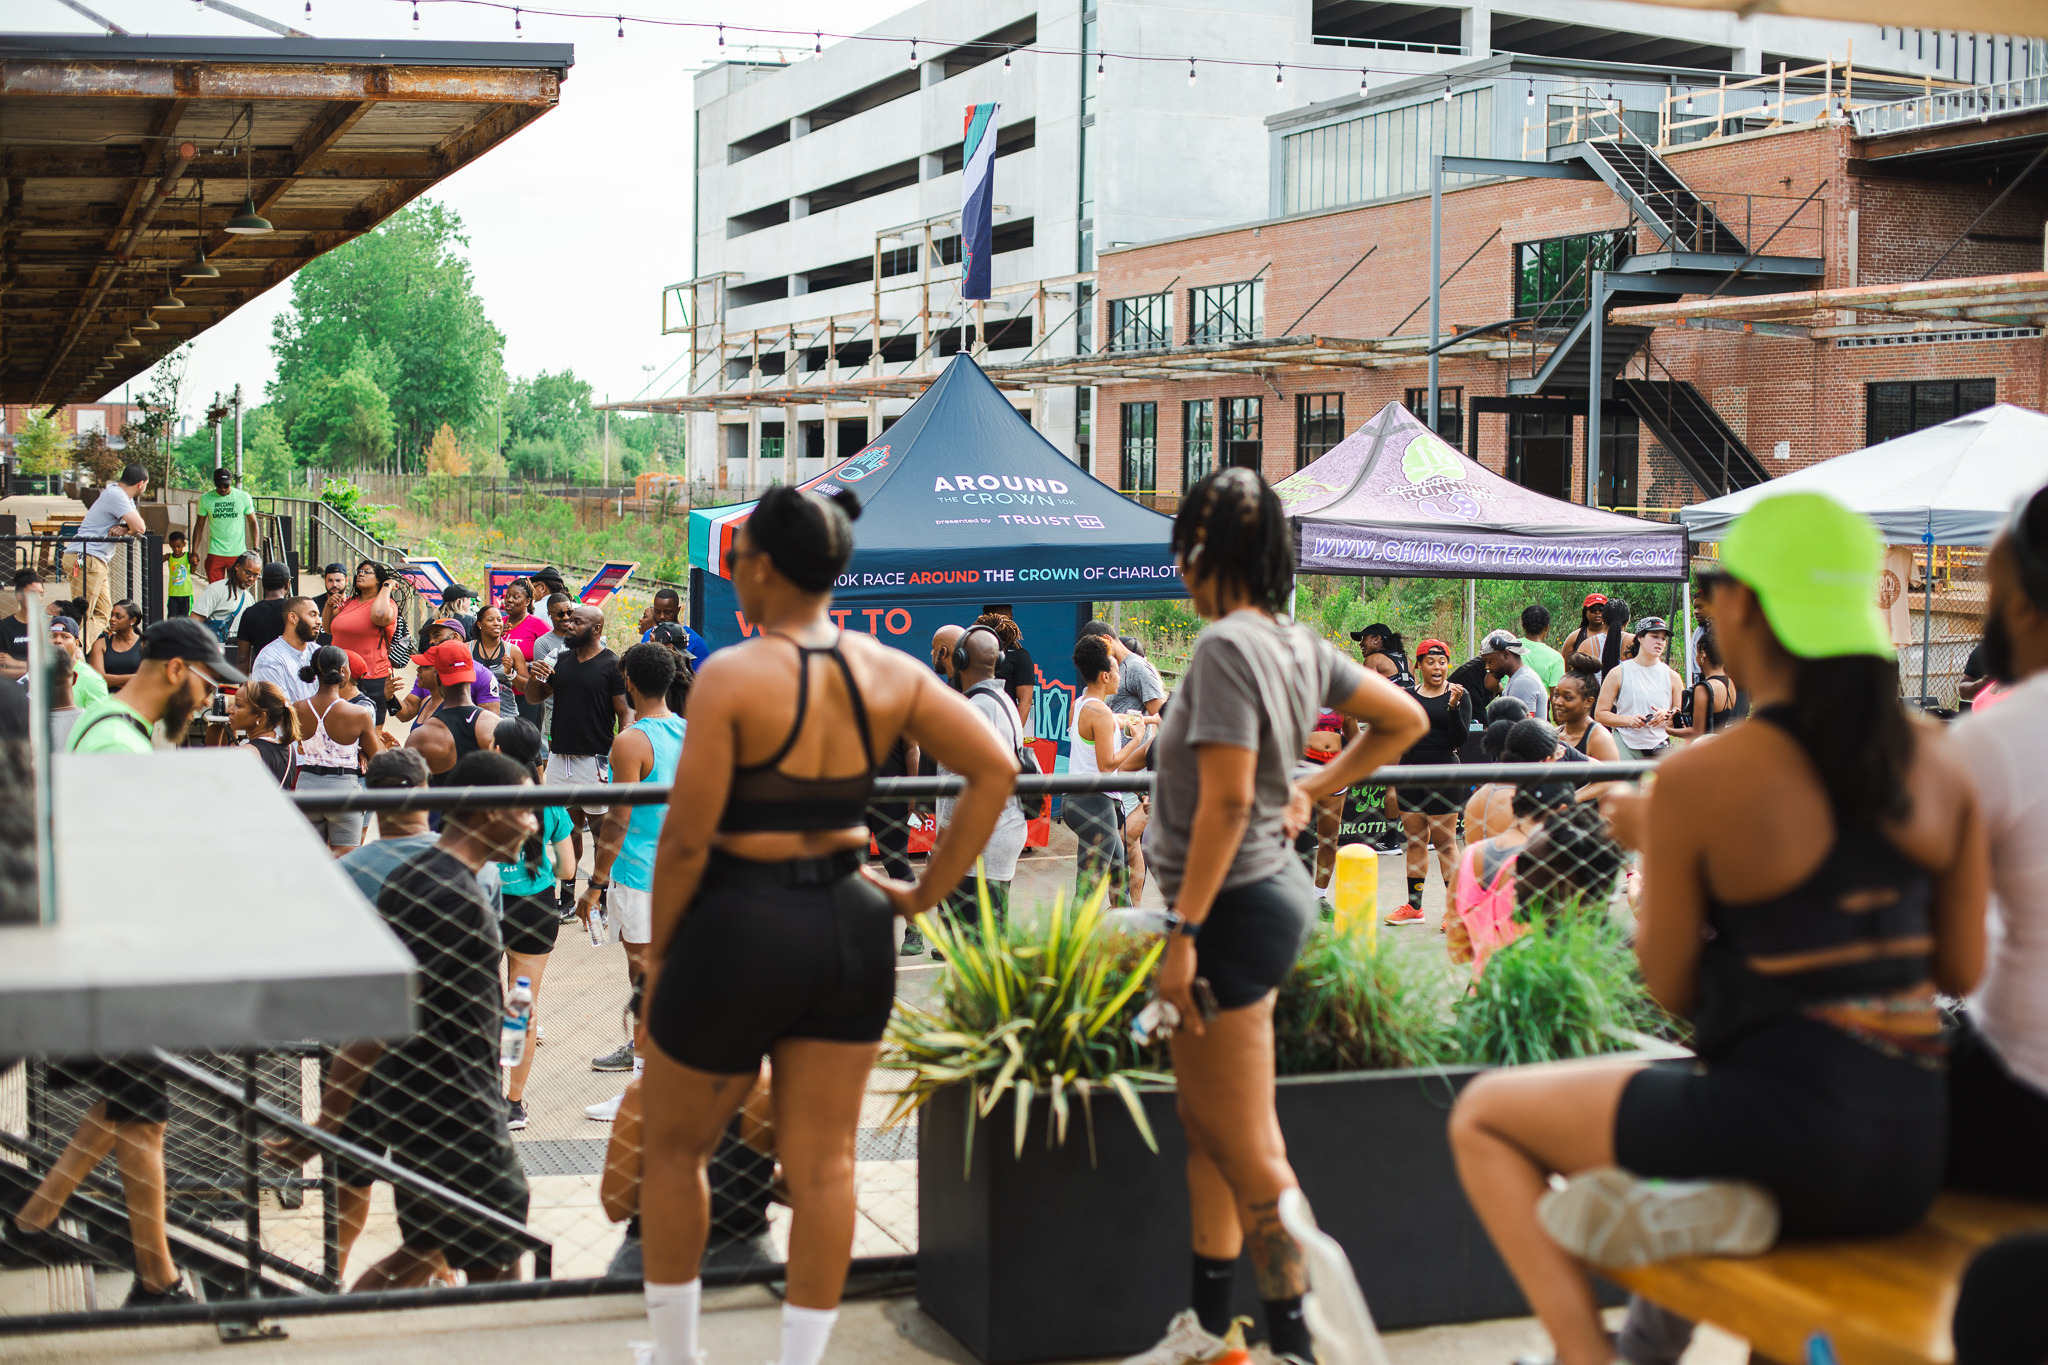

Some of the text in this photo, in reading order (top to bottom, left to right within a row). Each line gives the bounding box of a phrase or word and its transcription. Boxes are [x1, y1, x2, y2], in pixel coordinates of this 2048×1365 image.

[934, 475, 1069, 495] AROUND
[1402, 482, 1493, 501] RUNNING
[962, 492, 1055, 507] CROWN
[1057, 498, 1076, 506] 10K
[998, 515, 1070, 526] TRUIST
[1312, 537, 1677, 568] WWW.CHARLOTTERUNNING.COM
[863, 572, 905, 586] RACE
[908, 570, 980, 585] AROUND
[983, 569, 1015, 582] THE
[1018, 568, 1079, 581] CROWN
[1083, 567, 1104, 580] OF
[1108, 565, 1184, 579] CHARLOT
[862, 608, 912, 635] TO
